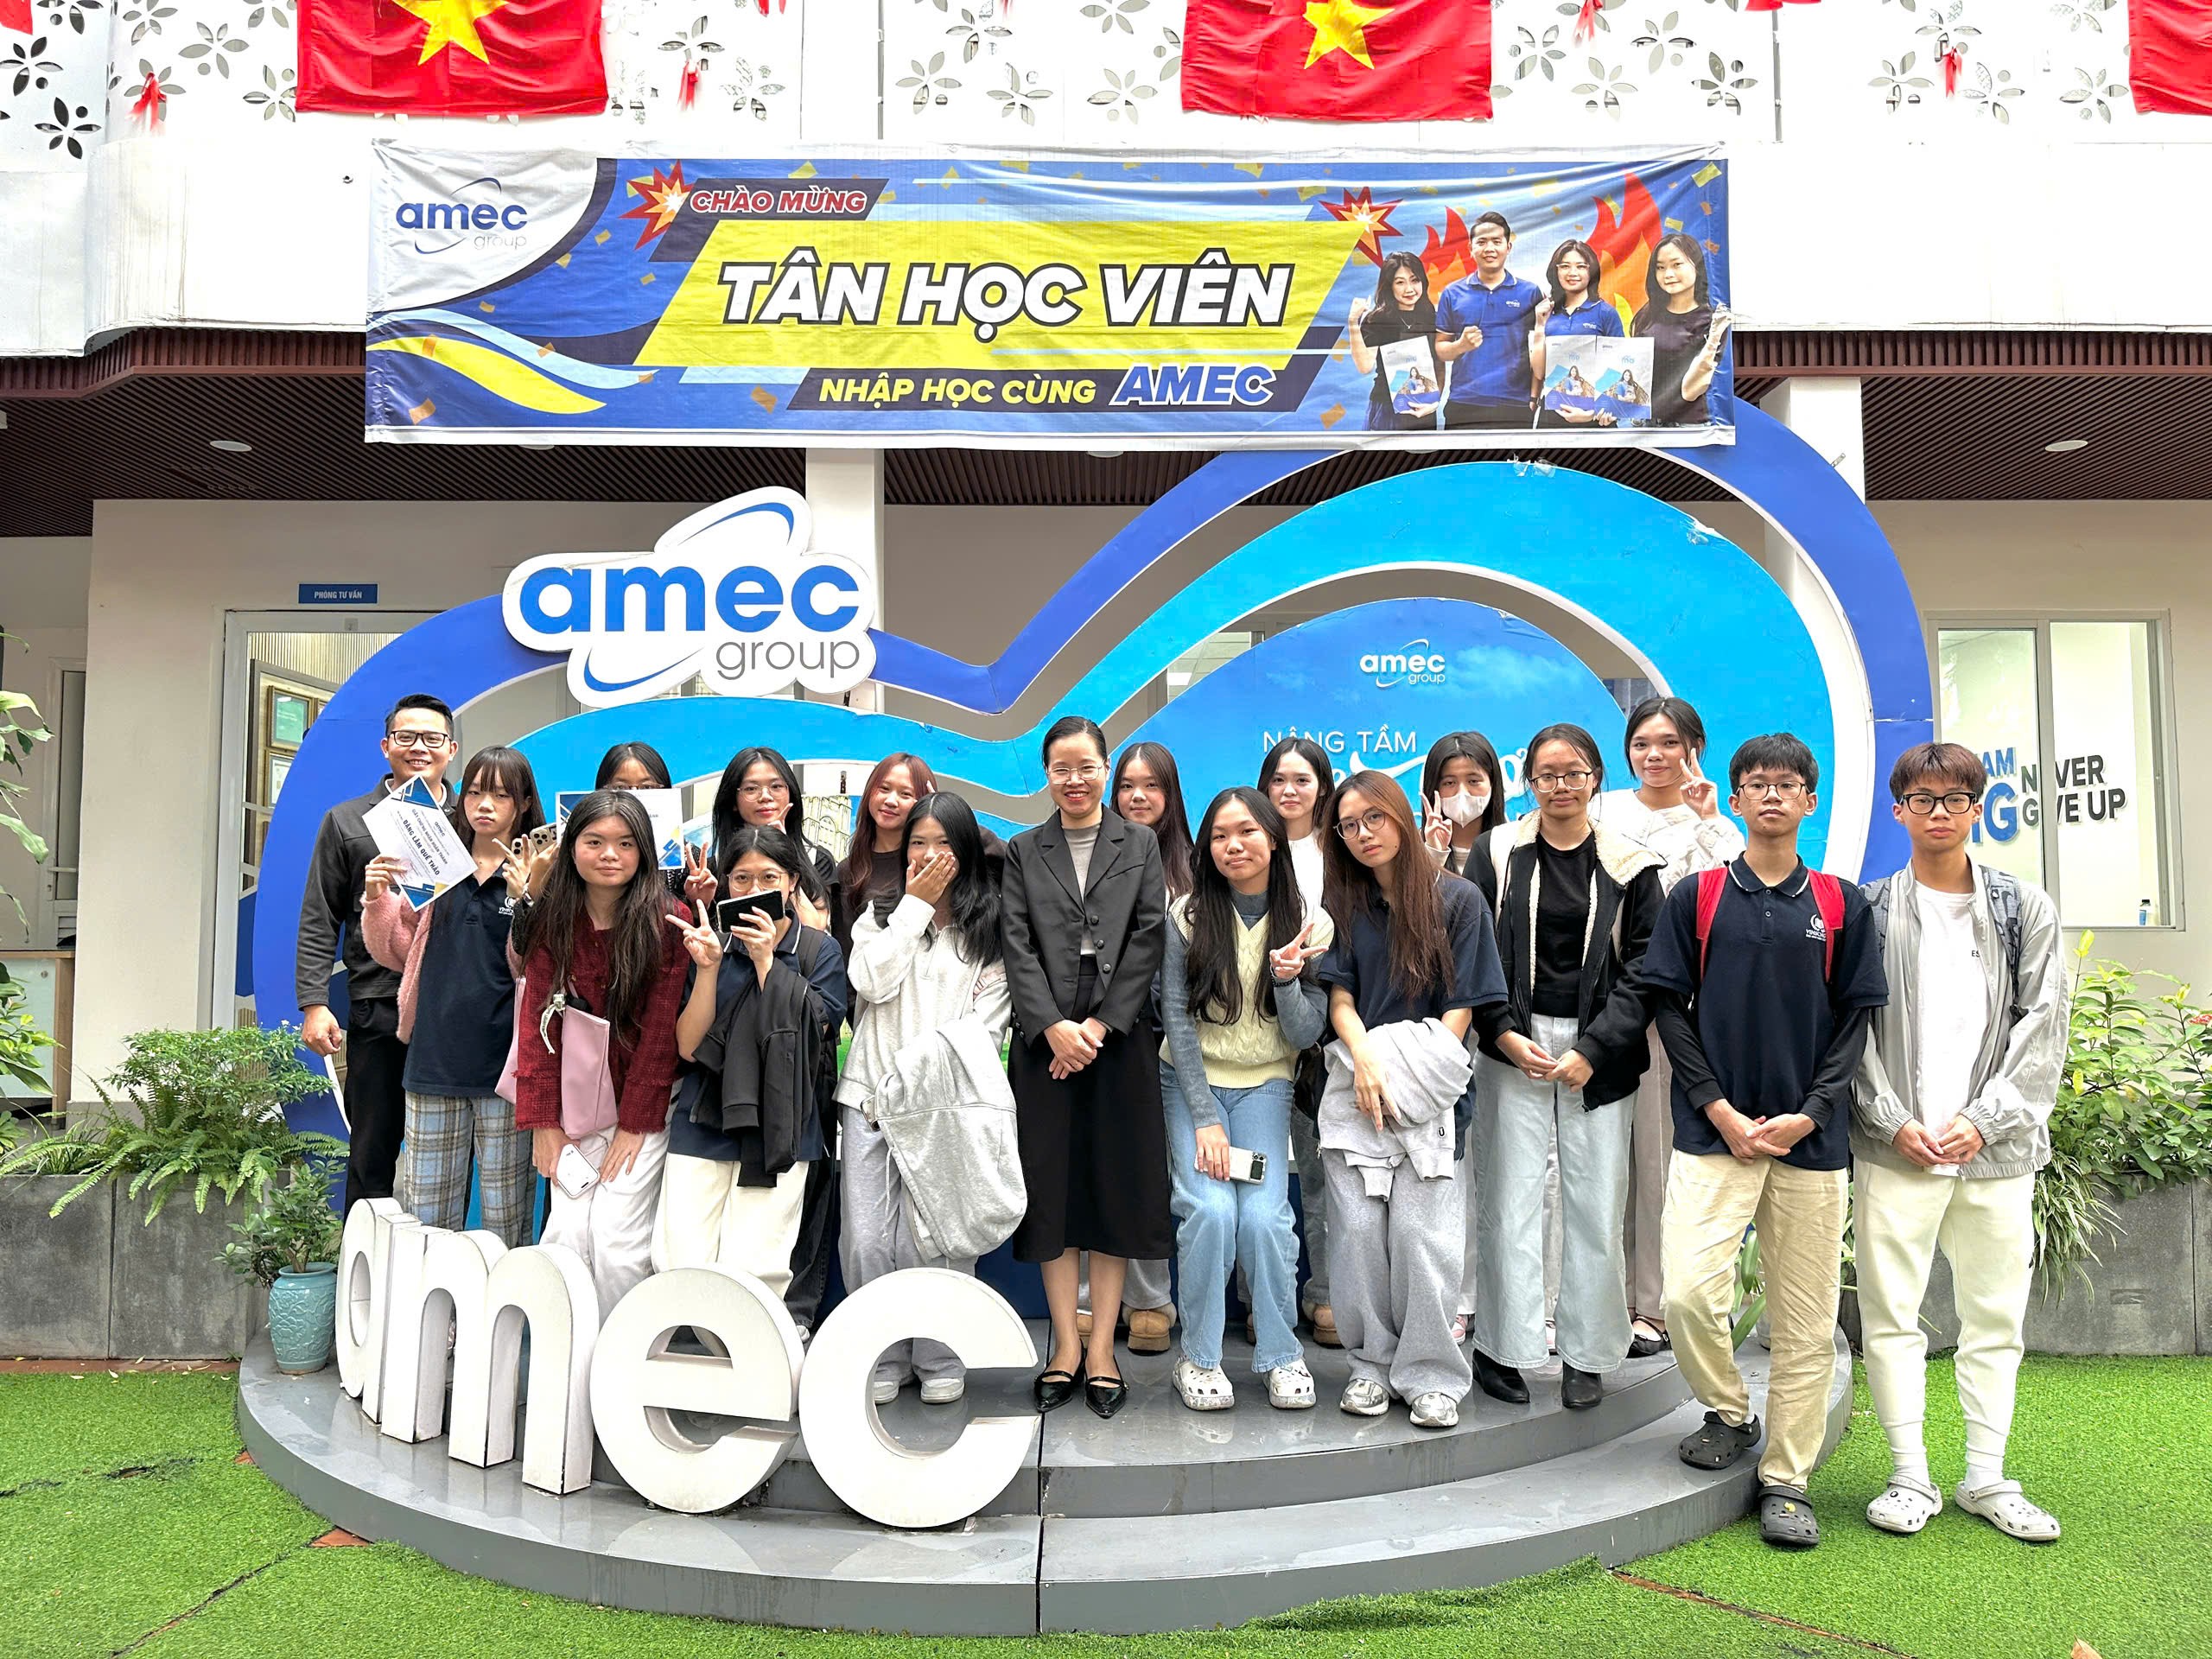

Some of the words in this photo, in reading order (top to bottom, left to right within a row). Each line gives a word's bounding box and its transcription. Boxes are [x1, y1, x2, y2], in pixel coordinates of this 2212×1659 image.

[396, 202, 528, 231] amec
[690, 185, 775, 213] CHÀO
[778, 185, 868, 213] MỪNG
[474, 235, 527, 251] group
[717, 246, 891, 325] TÂN
[896, 262, 1088, 343] HỌC
[1099, 247, 1295, 327] VIÊN
[819, 372, 915, 409] NHẬP
[920, 378, 995, 409] HỌC
[1001, 373, 1096, 404] CÙNG
[1109, 363, 1277, 406] AMEC
[519, 564, 860, 634] amec
[715, 640, 861, 680] group
[1359, 654, 1446, 673] amec
[1408, 673, 1446, 685] group
[1357, 724, 1417, 753] TẦM
[2020, 754, 2105, 793] NVER
[2022, 792, 2079, 827] GE
[2088, 787, 2126, 821] UP
[336, 1197, 1039, 1529] amec
